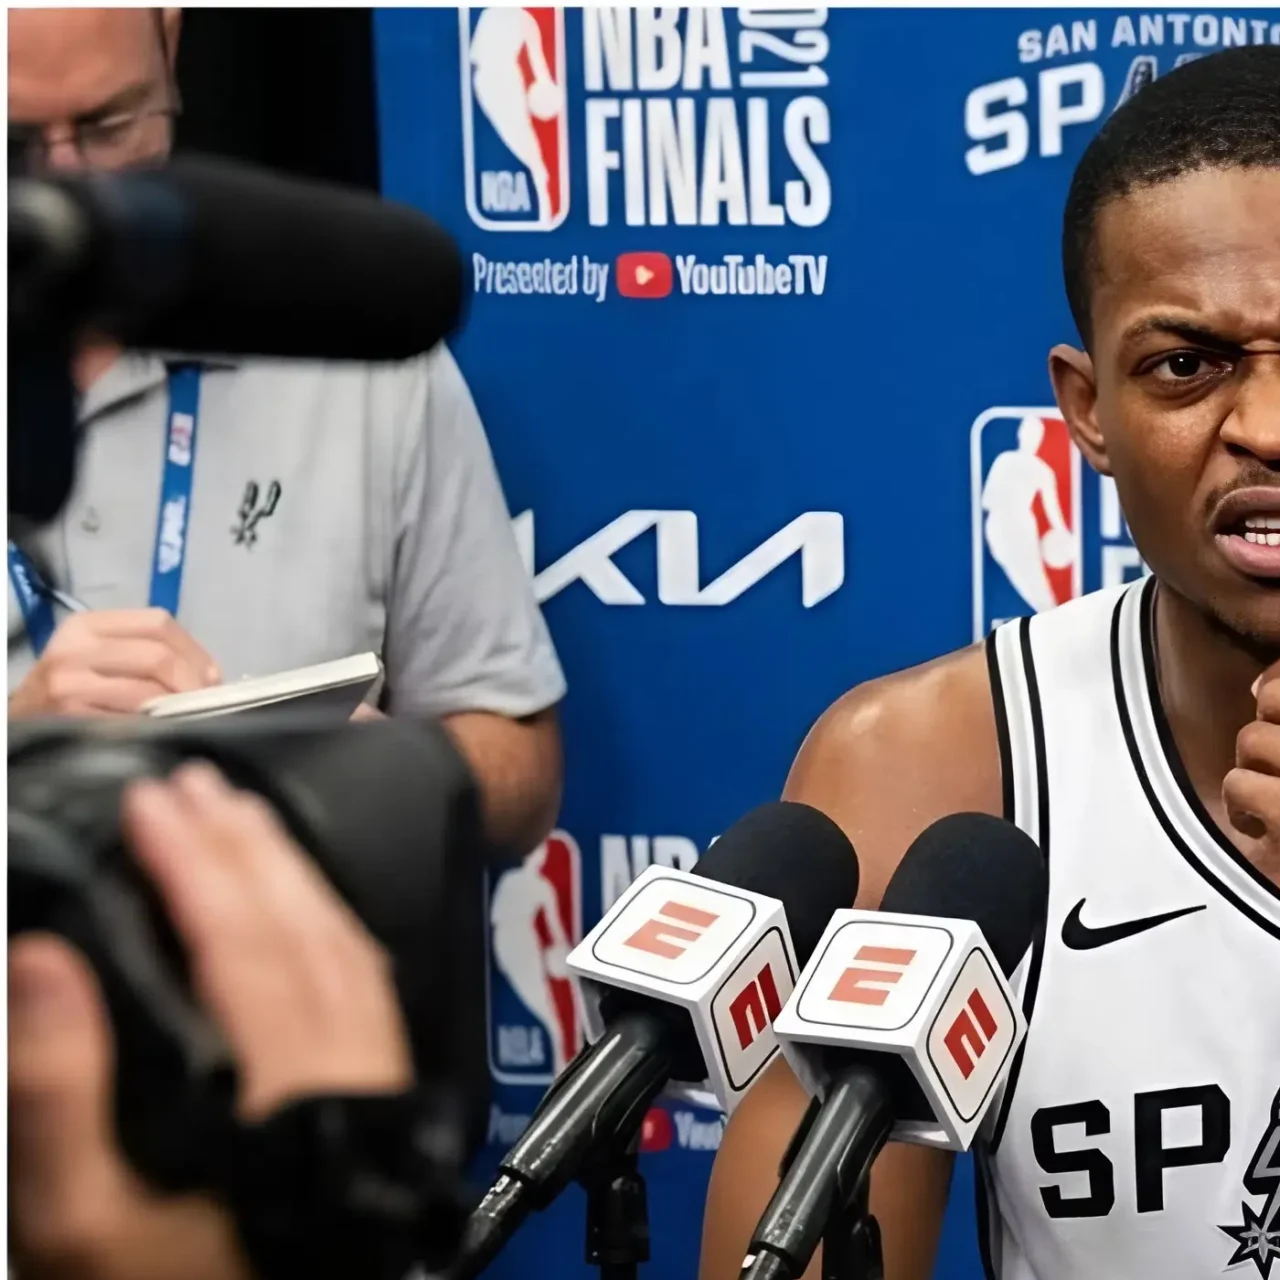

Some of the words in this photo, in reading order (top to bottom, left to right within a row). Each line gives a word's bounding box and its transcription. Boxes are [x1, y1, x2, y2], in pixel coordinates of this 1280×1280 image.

[1018, 20, 1097, 63] SAN
[585, 96, 832, 227] FINALS
[582, 254, 609, 303] by
